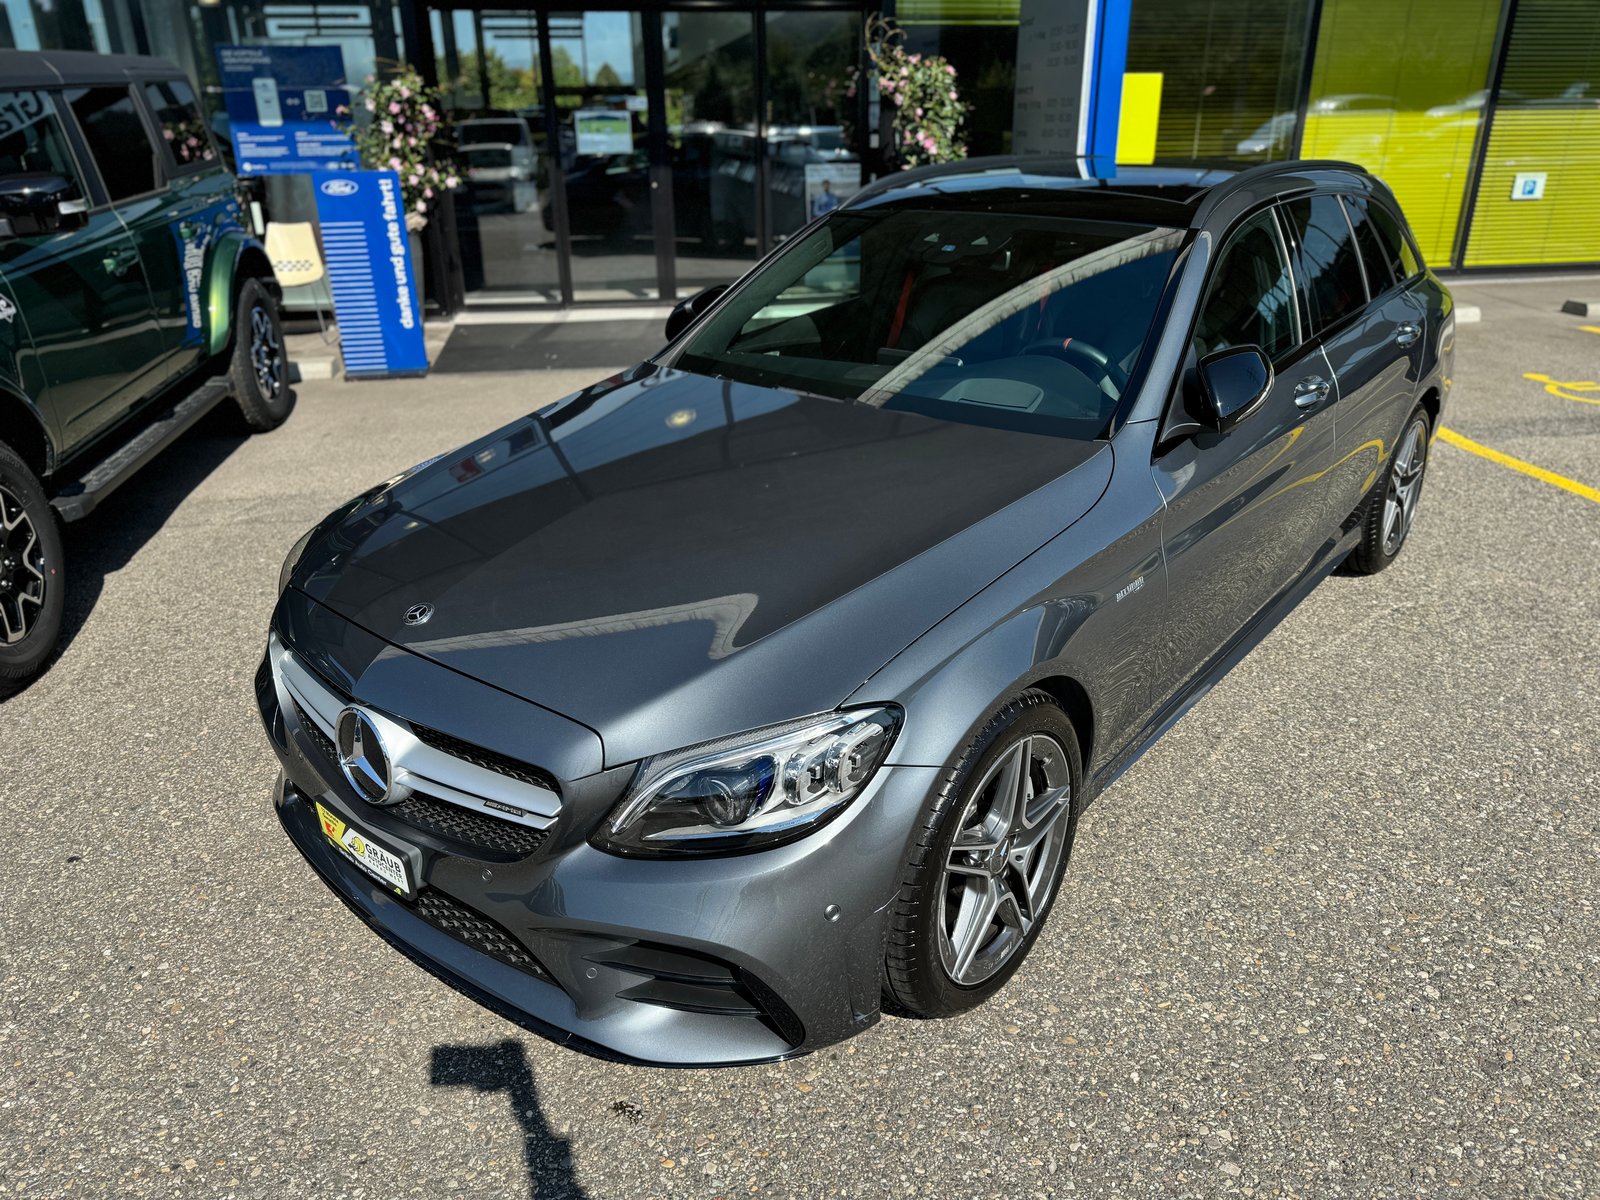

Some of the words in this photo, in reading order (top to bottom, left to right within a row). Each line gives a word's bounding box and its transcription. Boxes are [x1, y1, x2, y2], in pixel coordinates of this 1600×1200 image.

[378, 178, 397, 222] fahrt!
[387, 221, 405, 256] gute
[390, 256, 407, 286] und
[396, 285, 414, 329] danke
[365, 843, 401, 873] GRÄUB
[367, 854, 403, 880] AUTOCENTER
